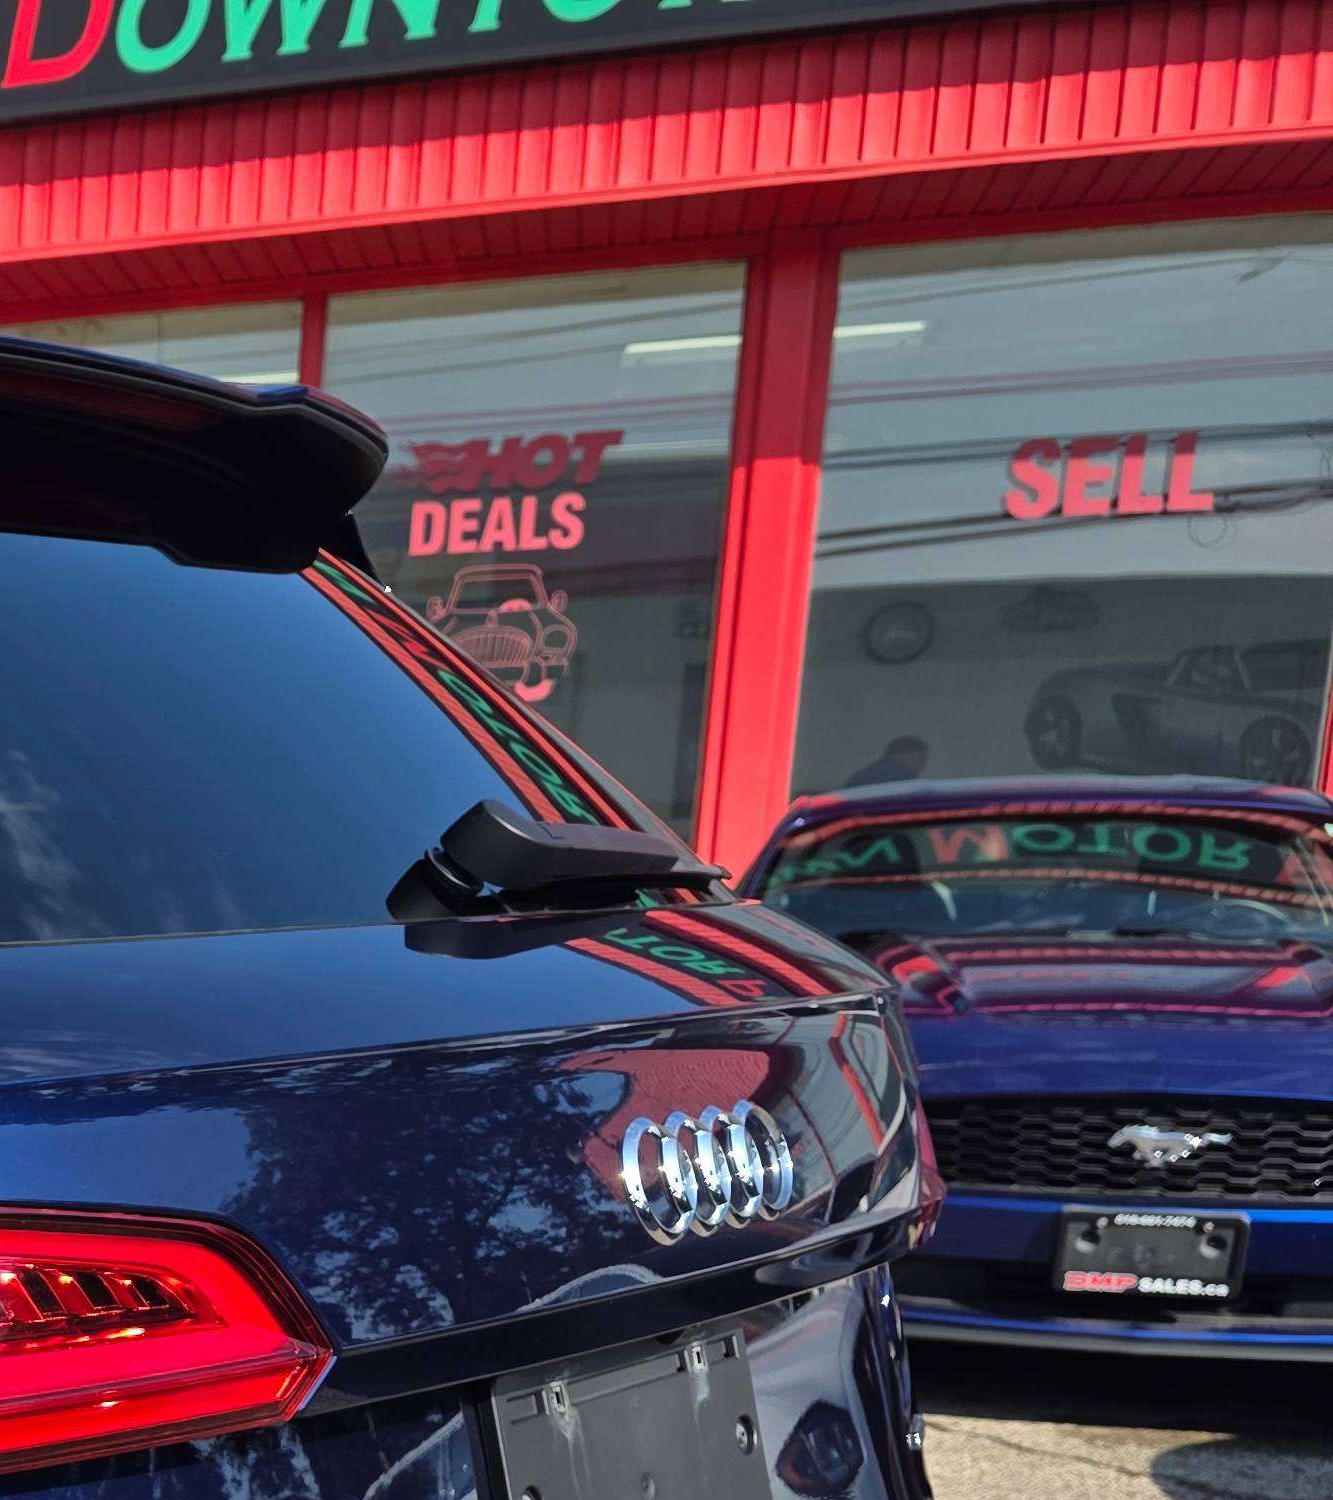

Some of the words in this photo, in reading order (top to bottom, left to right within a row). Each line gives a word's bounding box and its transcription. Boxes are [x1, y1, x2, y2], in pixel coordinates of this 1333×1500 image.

[443, 430, 625, 491] HOT
[1005, 430, 1215, 520] SELL
[408, 491, 587, 556] DEALS
